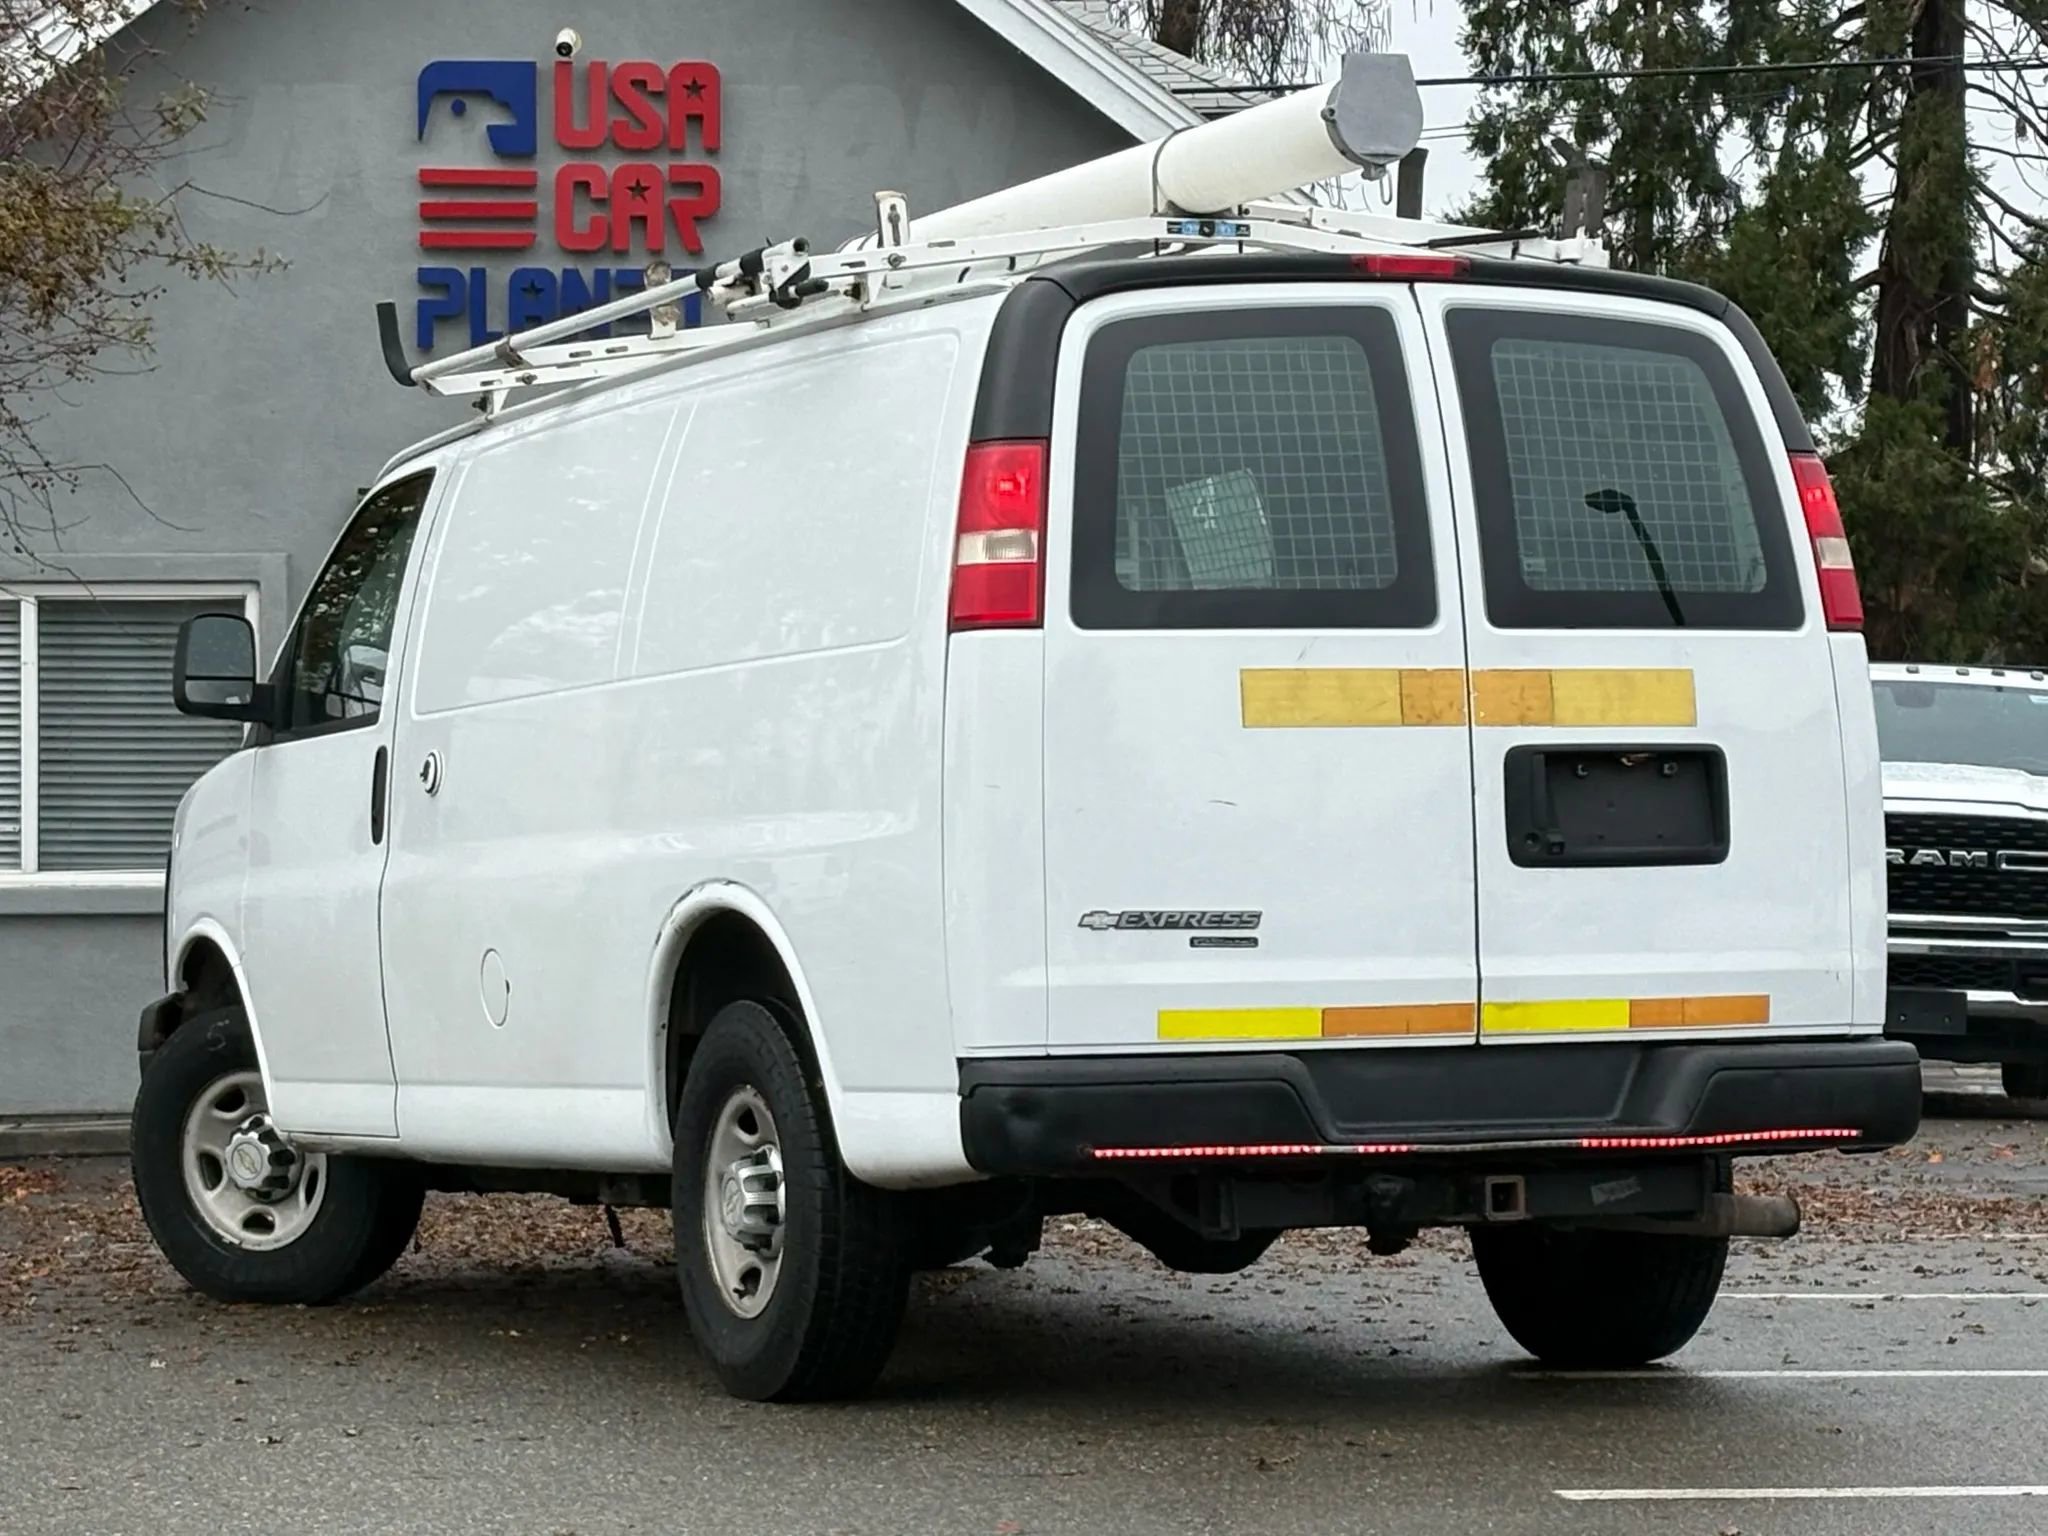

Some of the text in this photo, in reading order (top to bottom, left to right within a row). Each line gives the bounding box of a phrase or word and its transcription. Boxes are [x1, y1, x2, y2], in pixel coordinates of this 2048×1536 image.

[554, 60, 721, 151] USA
[555, 163, 721, 253] CAR
[1118, 910, 1261, 929] EXPRESS
